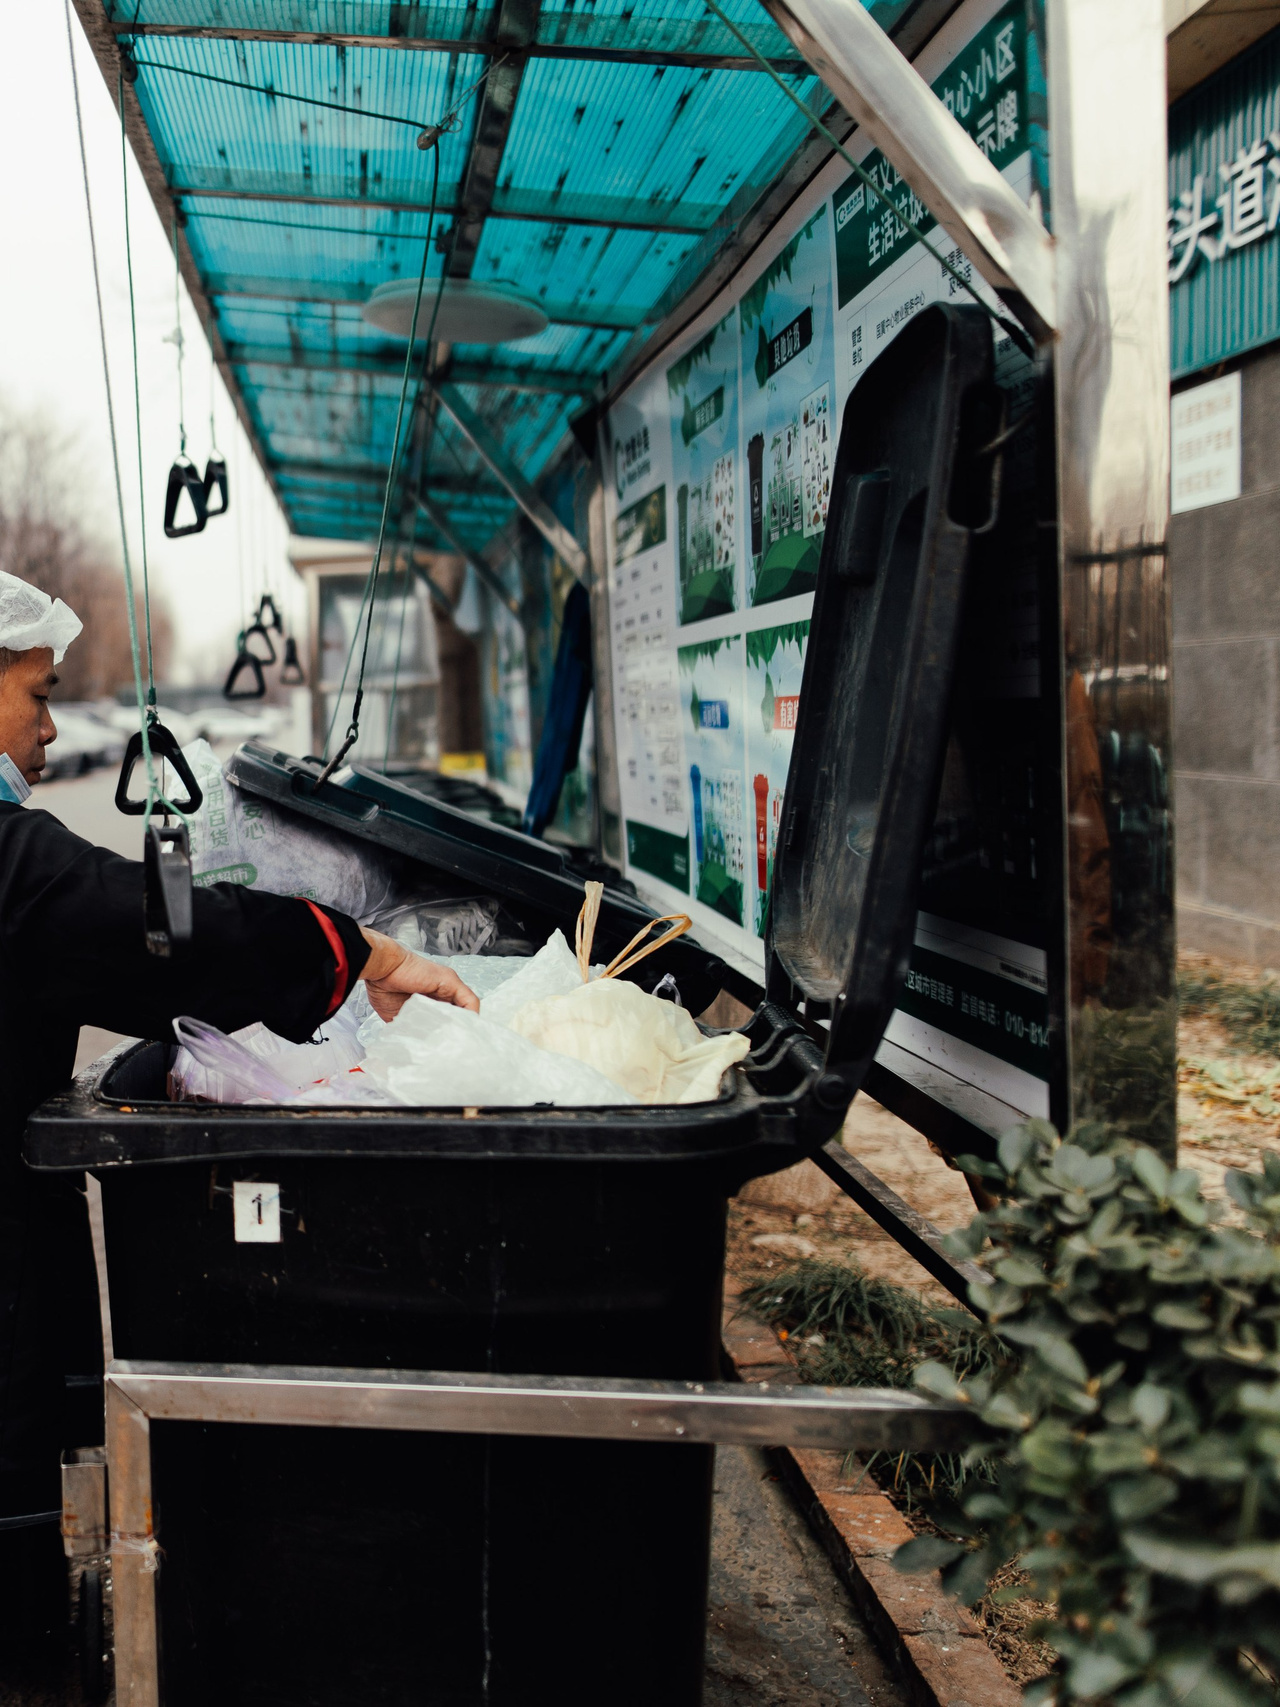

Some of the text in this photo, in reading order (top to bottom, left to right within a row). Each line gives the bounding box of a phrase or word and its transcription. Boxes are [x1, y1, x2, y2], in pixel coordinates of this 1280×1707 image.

[868, 89, 1019, 267] 生活垃圾 示牌
[1167, 130, 1280, 283] 头道
[242, 803, 267, 840] 安心
[905, 969, 955, 1007] 区城市管理委
[251, 1193, 263, 1225] 1
